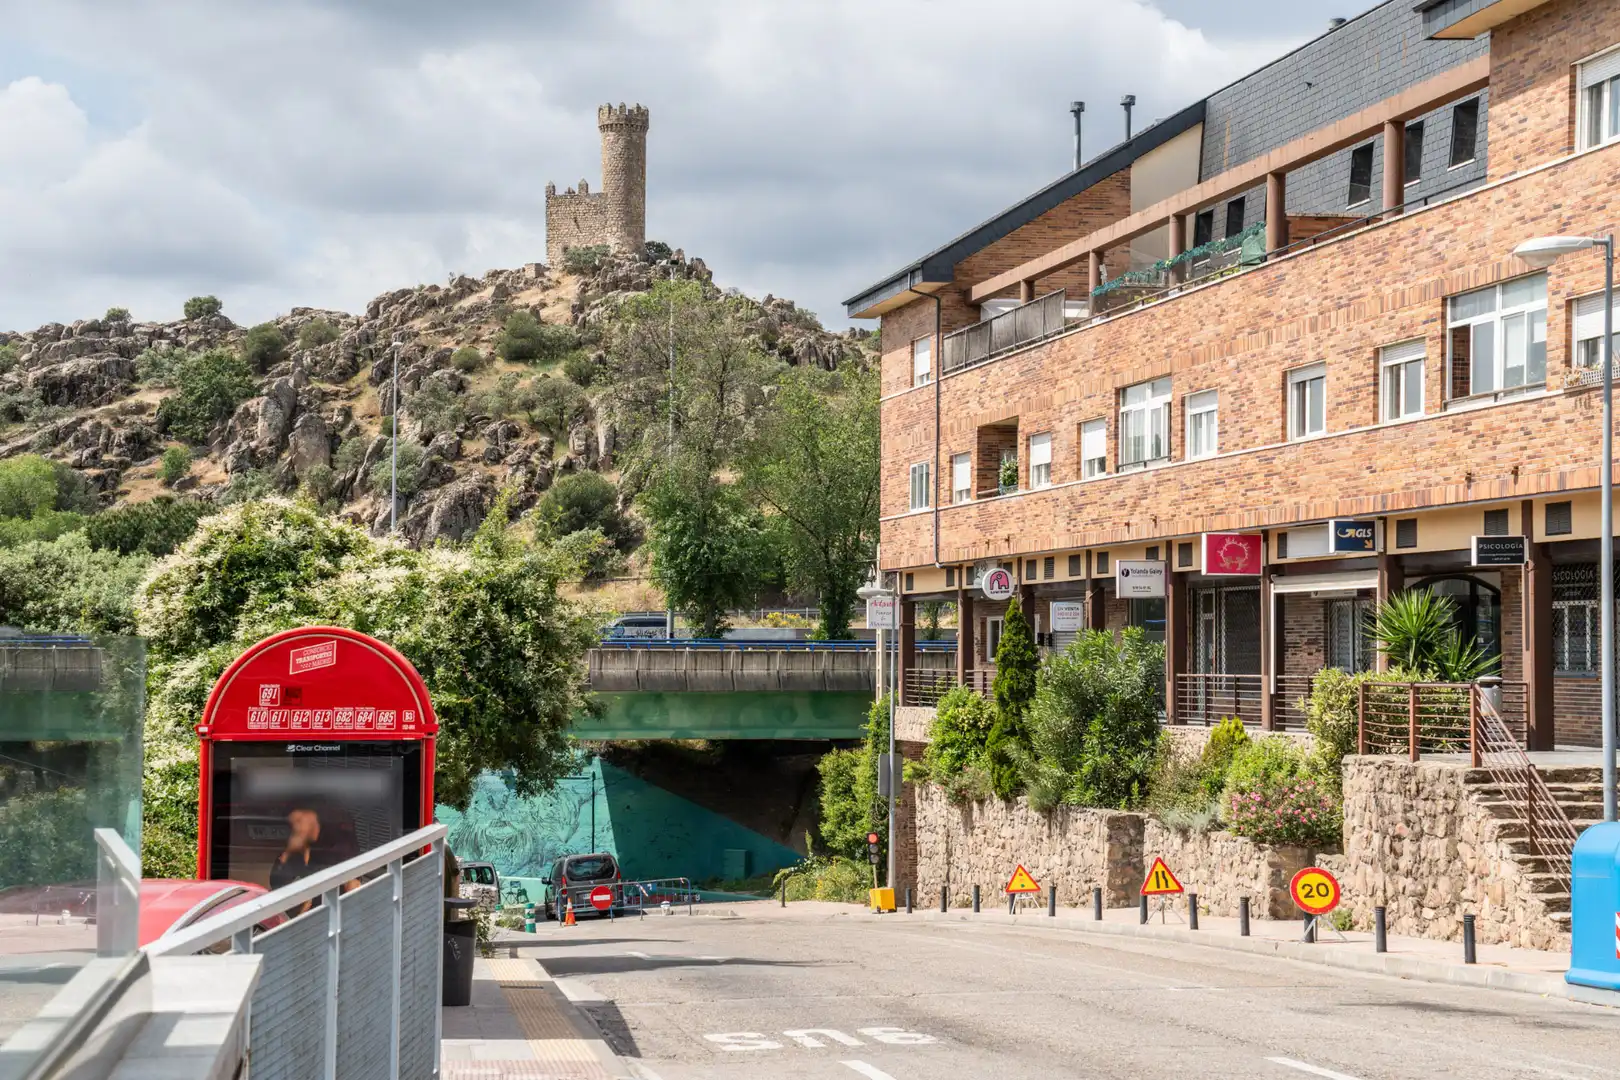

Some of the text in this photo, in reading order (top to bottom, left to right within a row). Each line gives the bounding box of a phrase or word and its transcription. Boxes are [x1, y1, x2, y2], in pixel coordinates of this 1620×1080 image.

[1355, 528, 1373, 538] GLS
[261, 688, 277, 699] 691
[250, 711, 267, 722] 610
[271, 711, 288, 722] 611
[293, 711, 309, 722] 612
[314, 711, 331, 722] 613
[335, 711, 352, 722] 682
[356, 711, 373, 722] 684
[378, 711, 394, 722] 685
[295, 744, 341, 752] Clear Channel
[1301, 883, 1330, 898] 20
[702, 1026, 941, 1052] BUS
